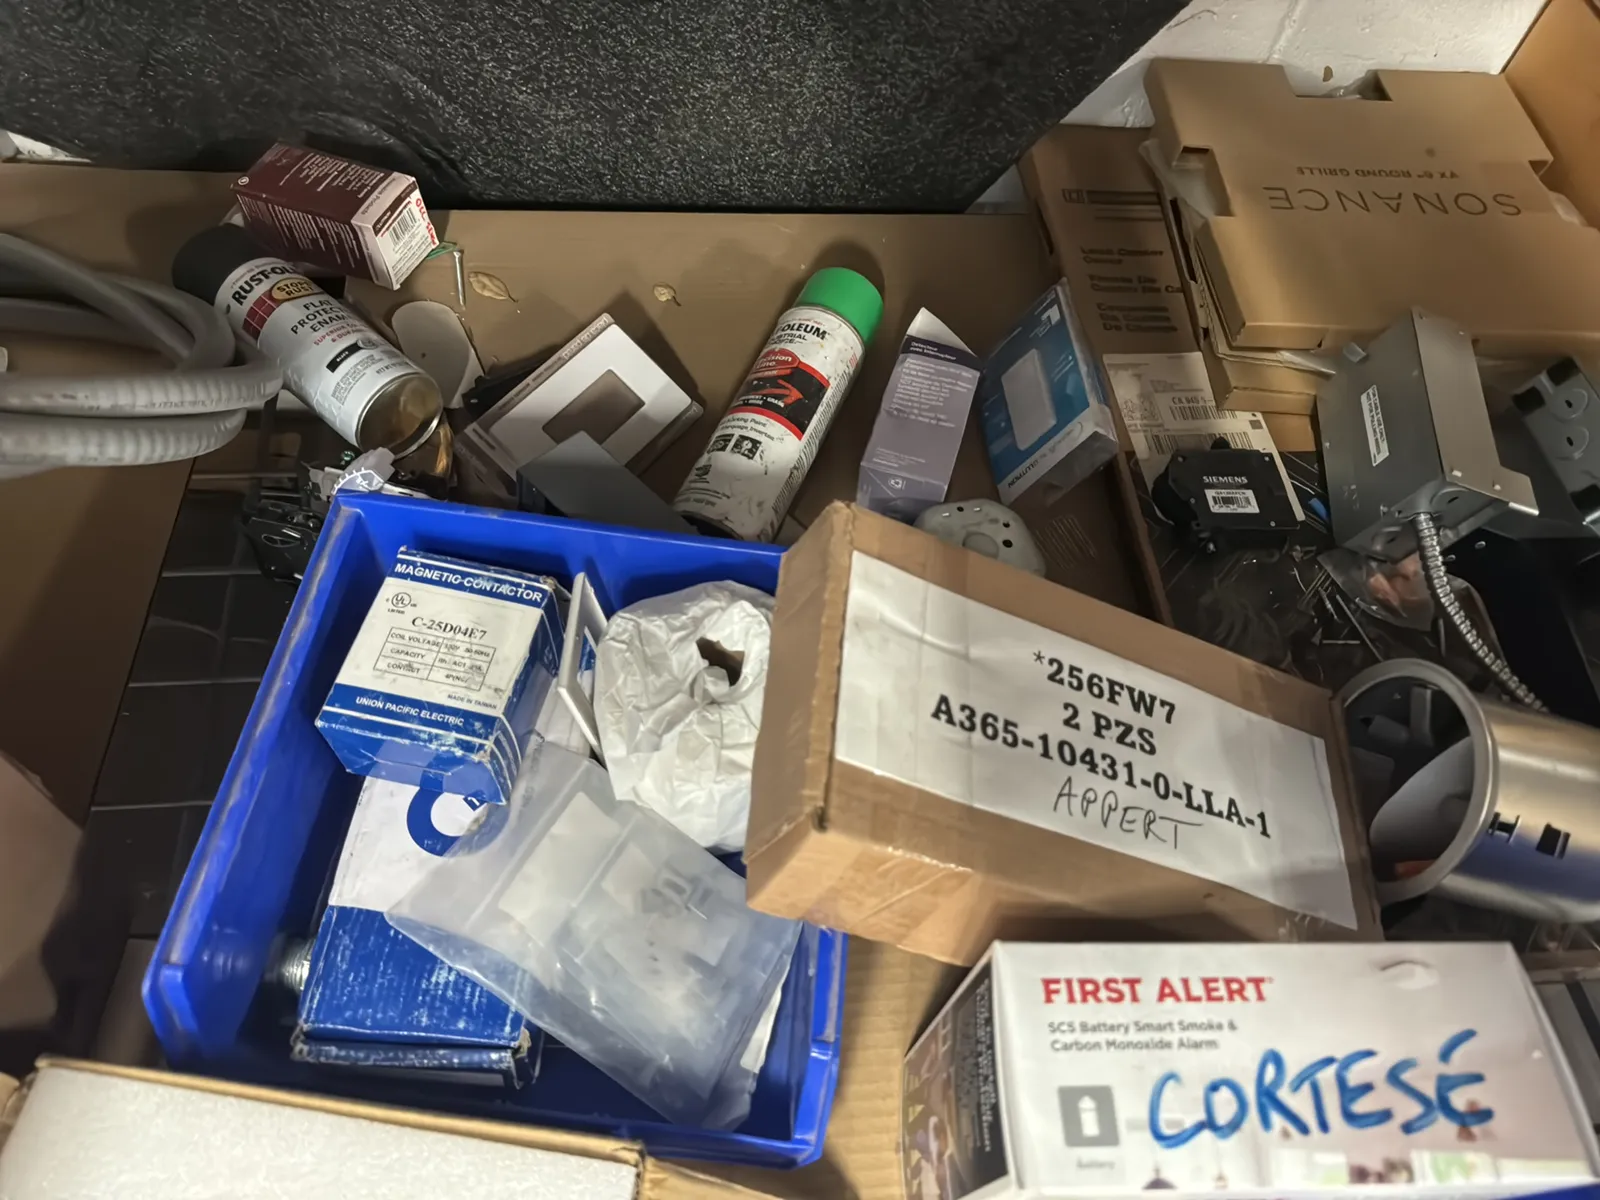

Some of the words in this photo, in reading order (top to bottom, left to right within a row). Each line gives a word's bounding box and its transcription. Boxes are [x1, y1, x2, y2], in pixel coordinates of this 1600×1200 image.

[1297, 166, 1350, 177] GRILLE
[1355, 169, 1412, 178] ROUND
[1262, 186, 1522, 216] SONANCE
[303, 300, 334, 311] FLAT
[1202, 475, 1249, 484] SIEMENS
[411, 616, 487, 640] C-25D04E7
[390, 632, 406, 641] COIL
[408, 635, 440, 648] VOLTAGE
[390, 648, 425, 659] CAPACITY
[447, 694, 465, 703] MADE
[474, 700, 497, 710] TAIWAN
[355, 696, 384, 709] UNION
[385, 702, 419, 716] PACIFIC
[420, 710, 465, 726] ELECTRIC
[1062, 702, 1081, 731] 2
[1092, 711, 1158, 755] PZS
[931, 694, 1272, 839] A365-10431-0-LLA-1
[1053, 775, 1205, 849] APPERT
[1040, 977, 1142, 1003] FIRST
[1156, 977, 1268, 1003] ALERT
[1080, 1021, 1130, 1035] Battery
[1134, 1020, 1175, 1033] Smart
[1178, 1019, 1223, 1032] Smoke
[1050, 1039, 1102, 1052] Carbon
[1105, 1038, 1173, 1051] Monoxide
[1177, 1038, 1220, 1050] Alarm
